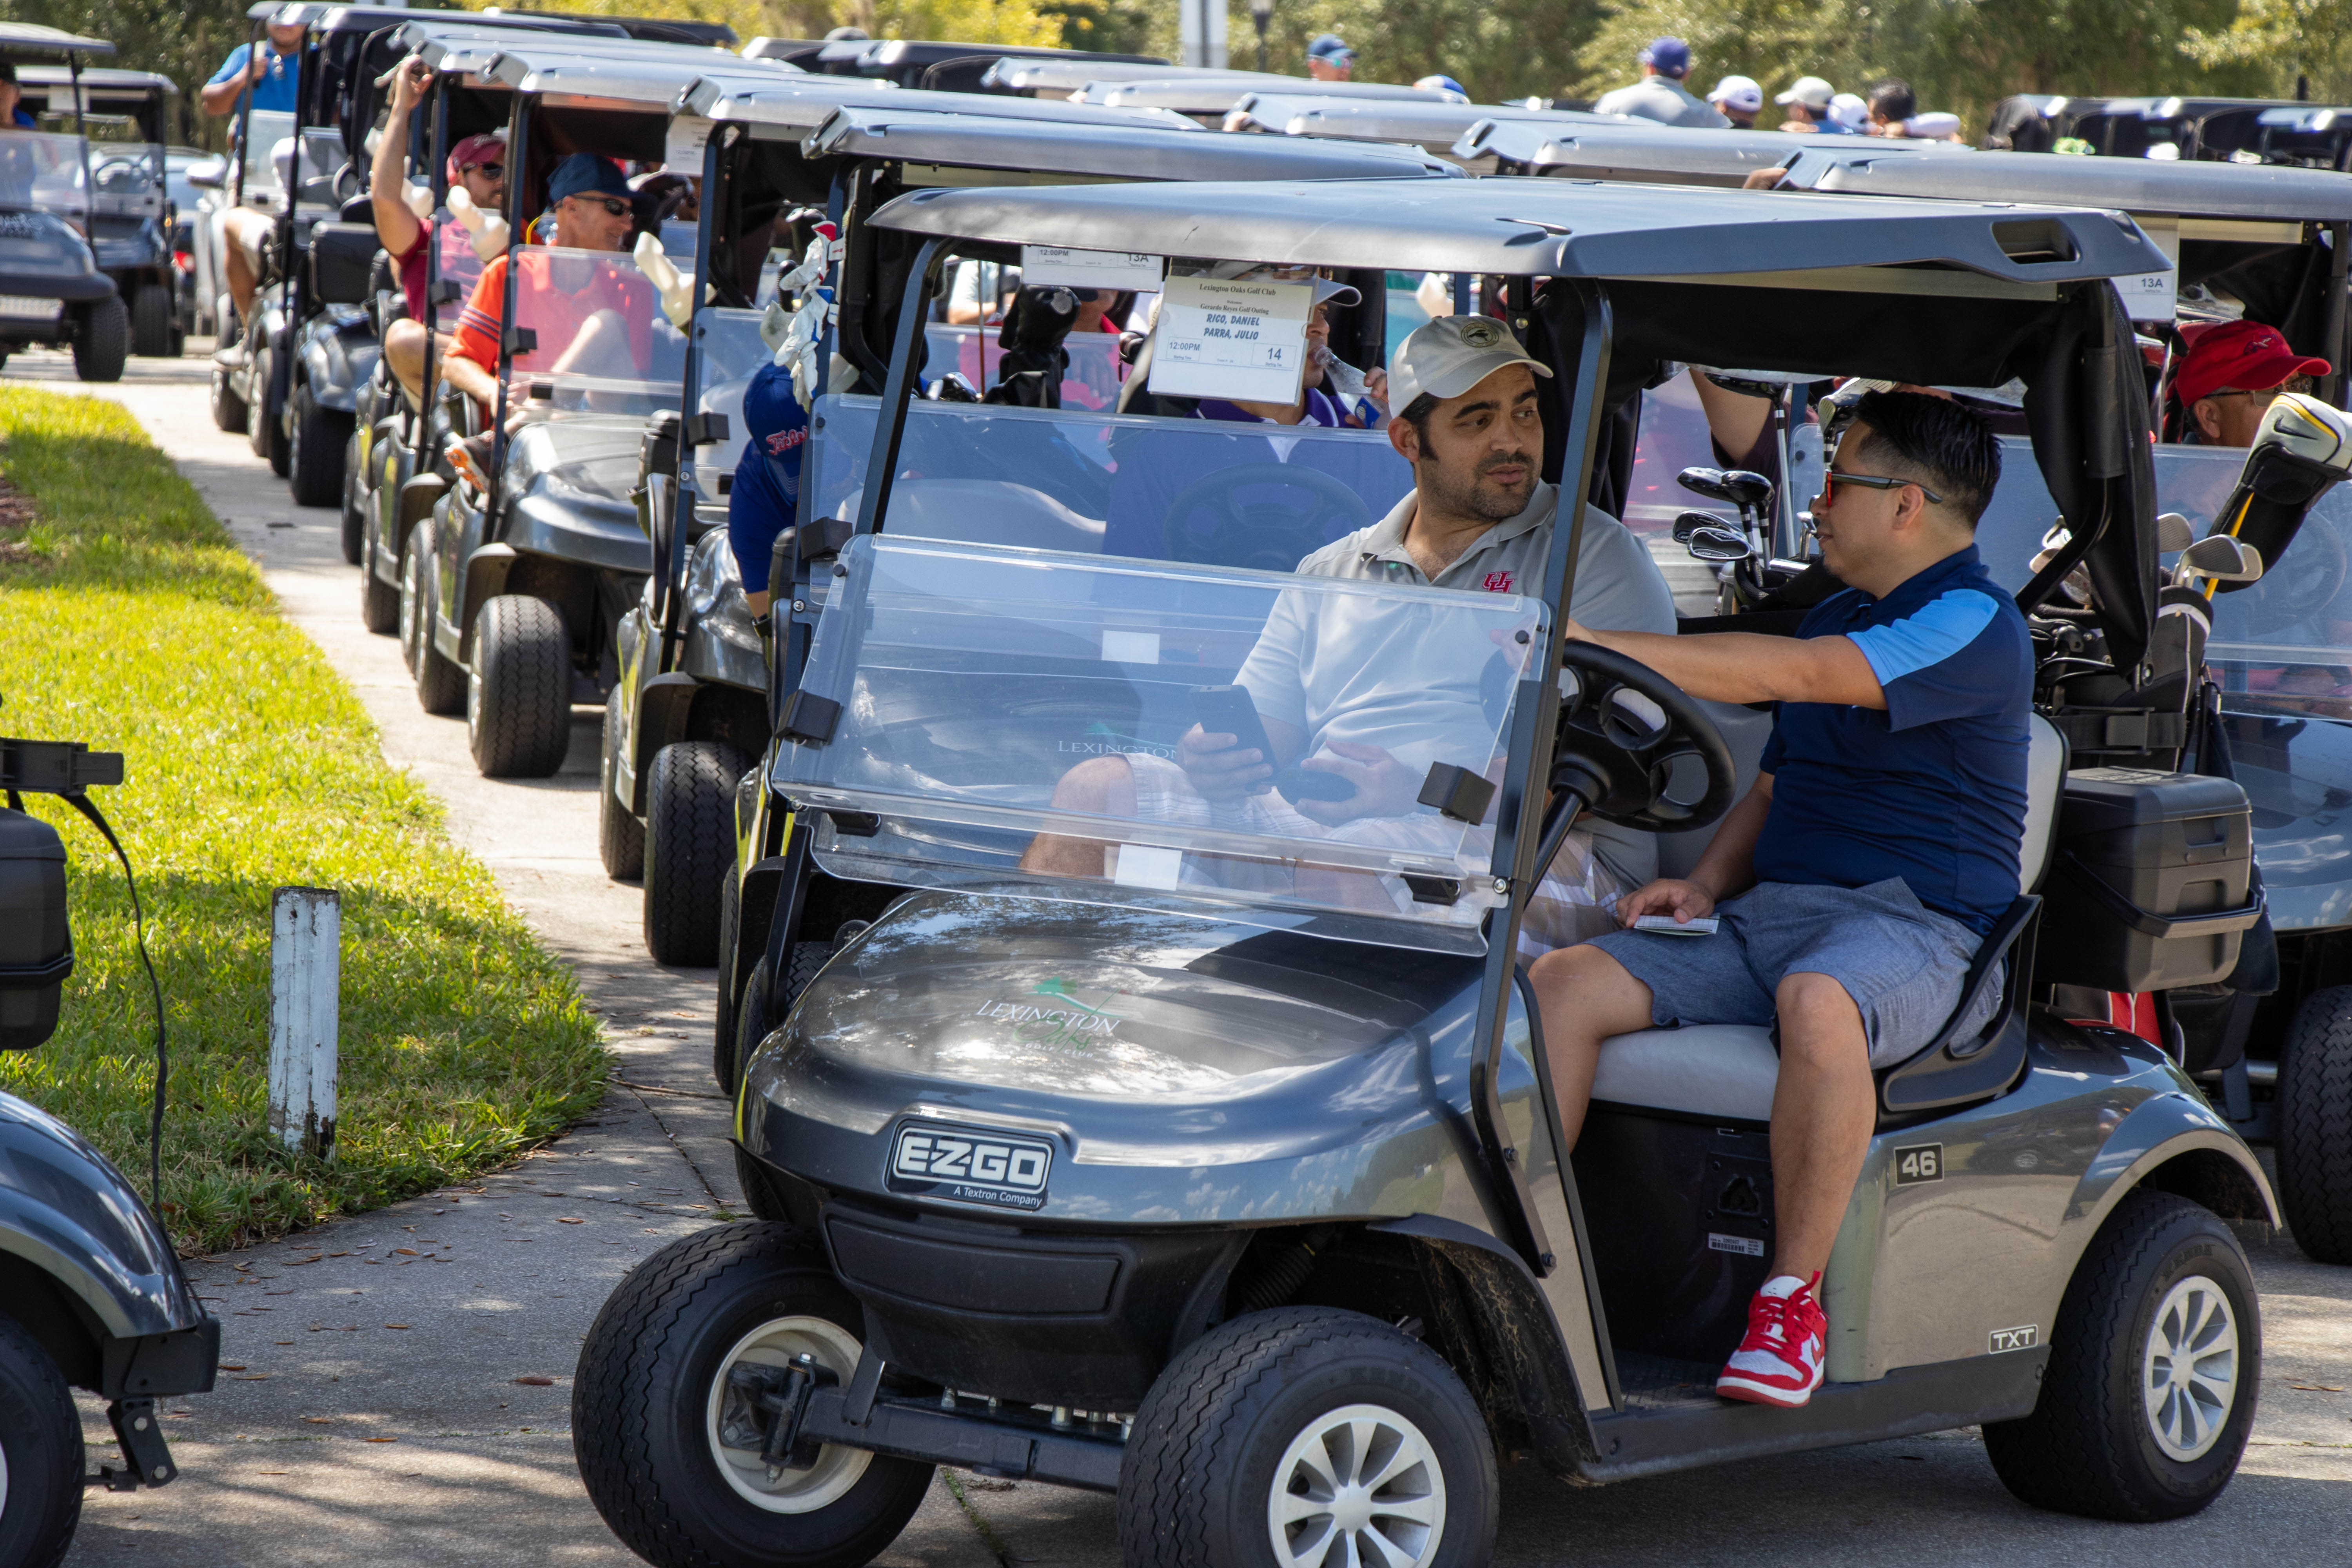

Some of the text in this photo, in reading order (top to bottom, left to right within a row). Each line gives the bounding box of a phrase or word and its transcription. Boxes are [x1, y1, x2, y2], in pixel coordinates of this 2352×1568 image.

[1127, 254, 1149, 262] 13A
[1200, 283, 1229, 292] Lexington
[2141, 278, 2163, 287] 13A
[1206, 314, 1259, 326] RICO, DANIEL
[1203, 327, 1259, 340] PARRA, JULIO
[1169, 341, 1200, 351] 12:00PM
[1267, 348, 1282, 360] 14
[766, 425, 808, 455] Titlei
[975, 999, 1121, 1033] LEXINGTON
[1013, 1015, 1092, 1052] Oaks
[1025, 1042, 1094, 1058] GOLF CLUB
[1901, 1151, 1937, 1177] 46
[953, 1186, 1042, 1208] A Textron Company
[1993, 1327, 2036, 1350] TXT
